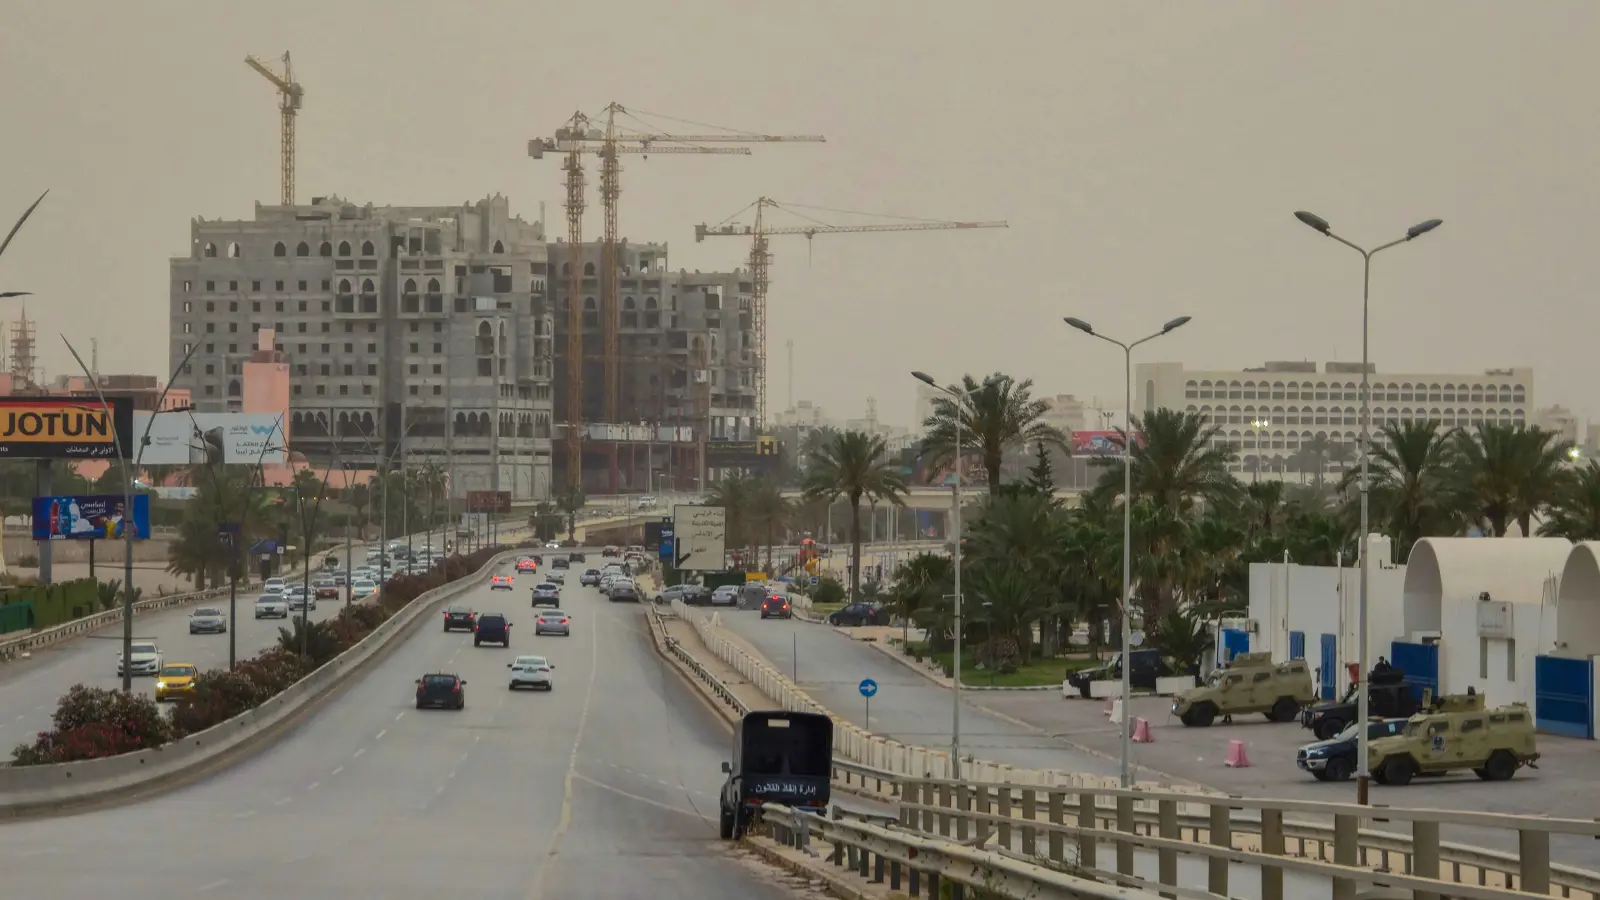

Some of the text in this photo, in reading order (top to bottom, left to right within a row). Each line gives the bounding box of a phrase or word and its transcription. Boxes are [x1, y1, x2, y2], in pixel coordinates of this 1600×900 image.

[3, 412, 107, 436] JOTUN
[91, 447, 98, 455] في
[755, 783, 780, 793] القانون
[799, 784, 816, 796] إدارة
